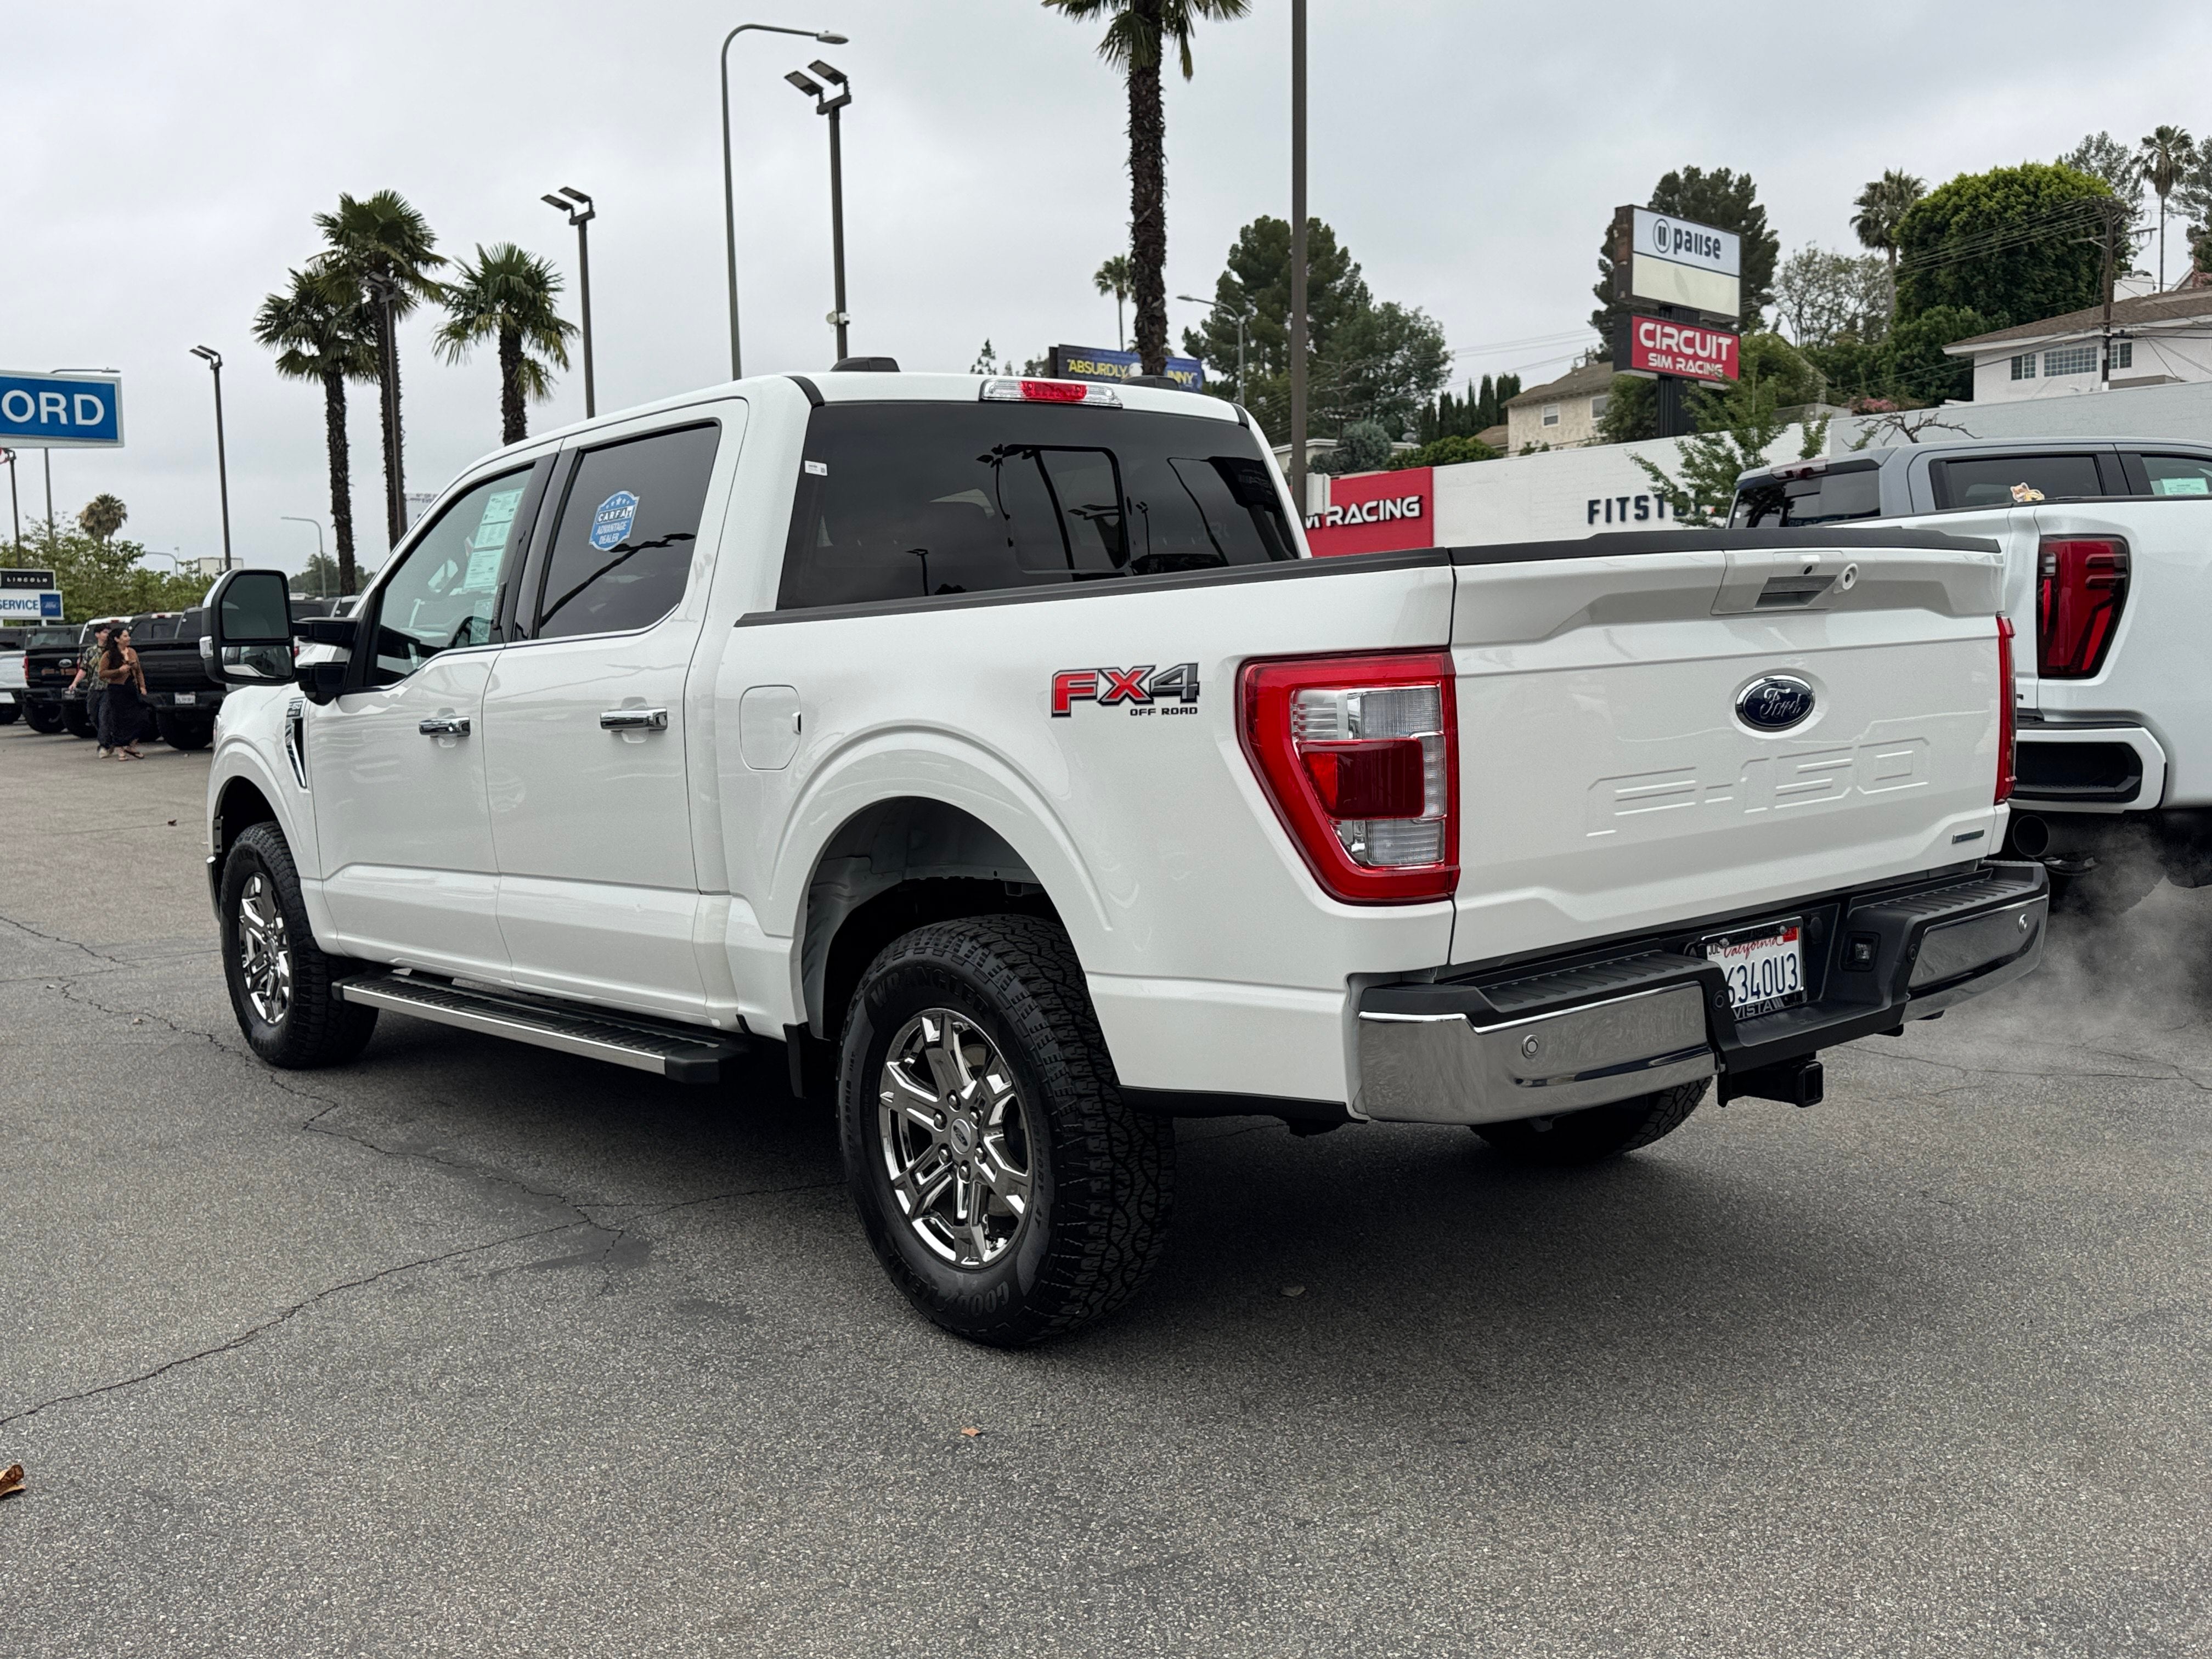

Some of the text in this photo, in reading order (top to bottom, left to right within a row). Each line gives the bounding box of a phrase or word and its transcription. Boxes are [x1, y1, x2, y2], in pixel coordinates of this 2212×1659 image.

[1673, 227, 1721, 259] pause
[1639, 322, 1733, 361] CIRCUIT
[1648, 353, 1723, 379] SIM RACING
[2, 390, 105, 426] ORD
[598, 507, 633, 522] CARFAX
[1325, 495, 1420, 527] RACING
[1051, 662, 1200, 718] FX4
[1759, 687, 1802, 719] Ford
[1130, 707, 1198, 716] OFF ROAD
[1587, 737, 1930, 837] F-150
[1723, 936, 1785, 960] California
[1733, 1000, 1773, 1020] VISTA
